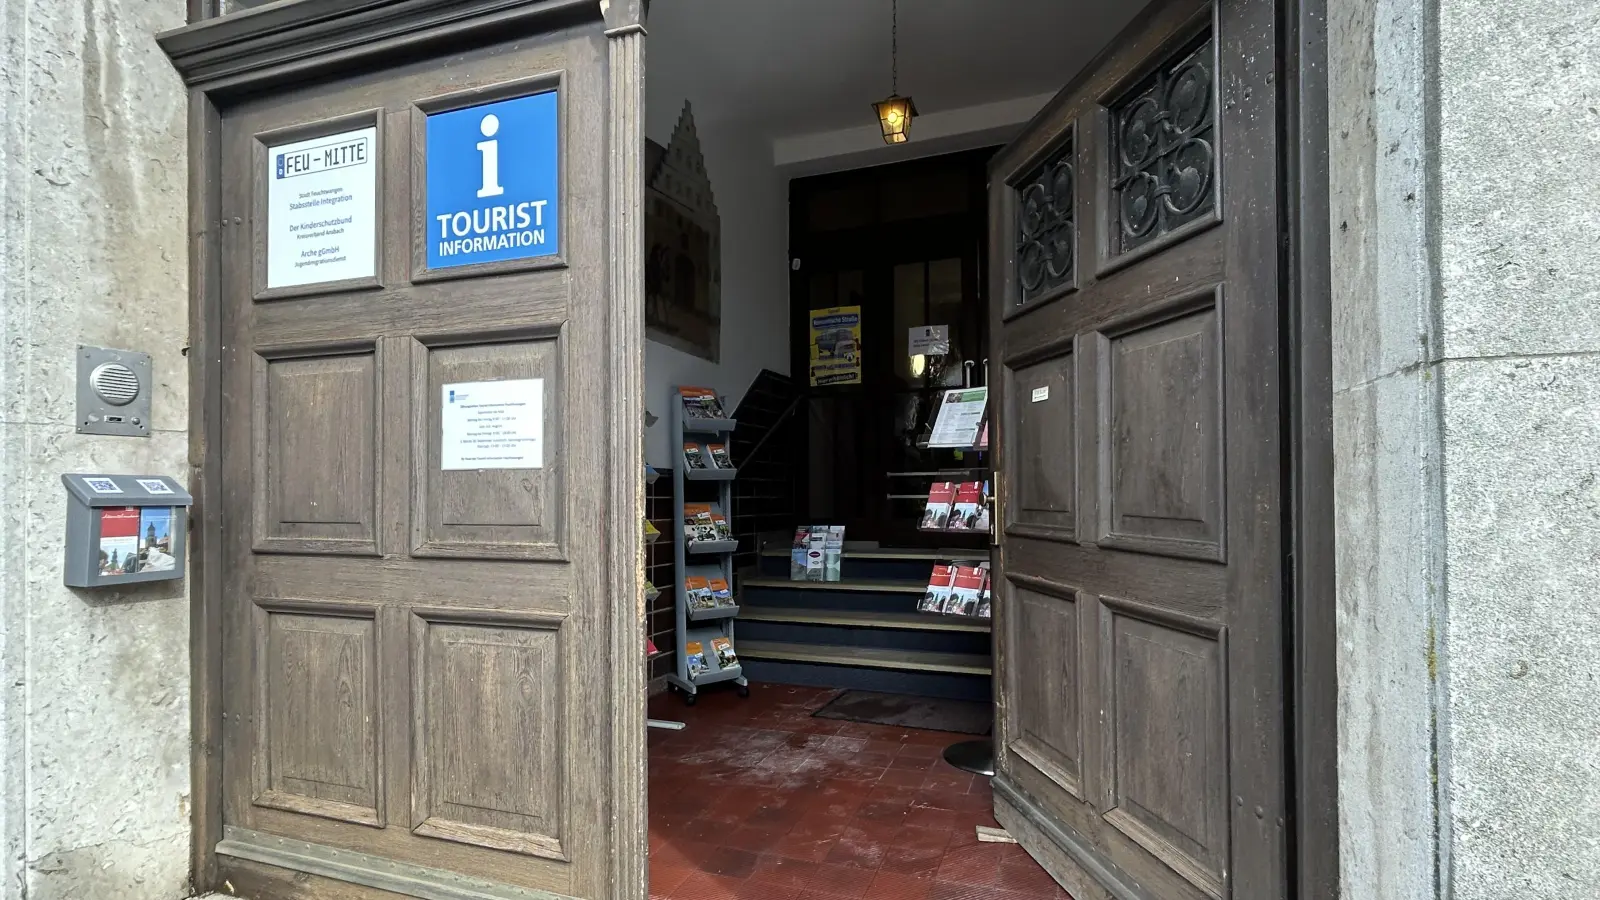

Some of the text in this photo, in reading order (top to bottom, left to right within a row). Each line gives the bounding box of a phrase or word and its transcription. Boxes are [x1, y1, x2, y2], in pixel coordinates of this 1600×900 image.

[286, 153, 310, 174] FEU
[324, 142, 365, 167] MITTE
[311, 187, 343, 196] Feuchtwangen
[289, 194, 353, 210] Stabsstelle Integration
[289, 215, 352, 232] Der Kinderschutzbund
[436, 199, 548, 239] TOURIST
[297, 227, 345, 240] Kreisverband Ansbach
[439, 228, 545, 257] INFORMATION
[301, 245, 340, 258] Arche gGmbH
